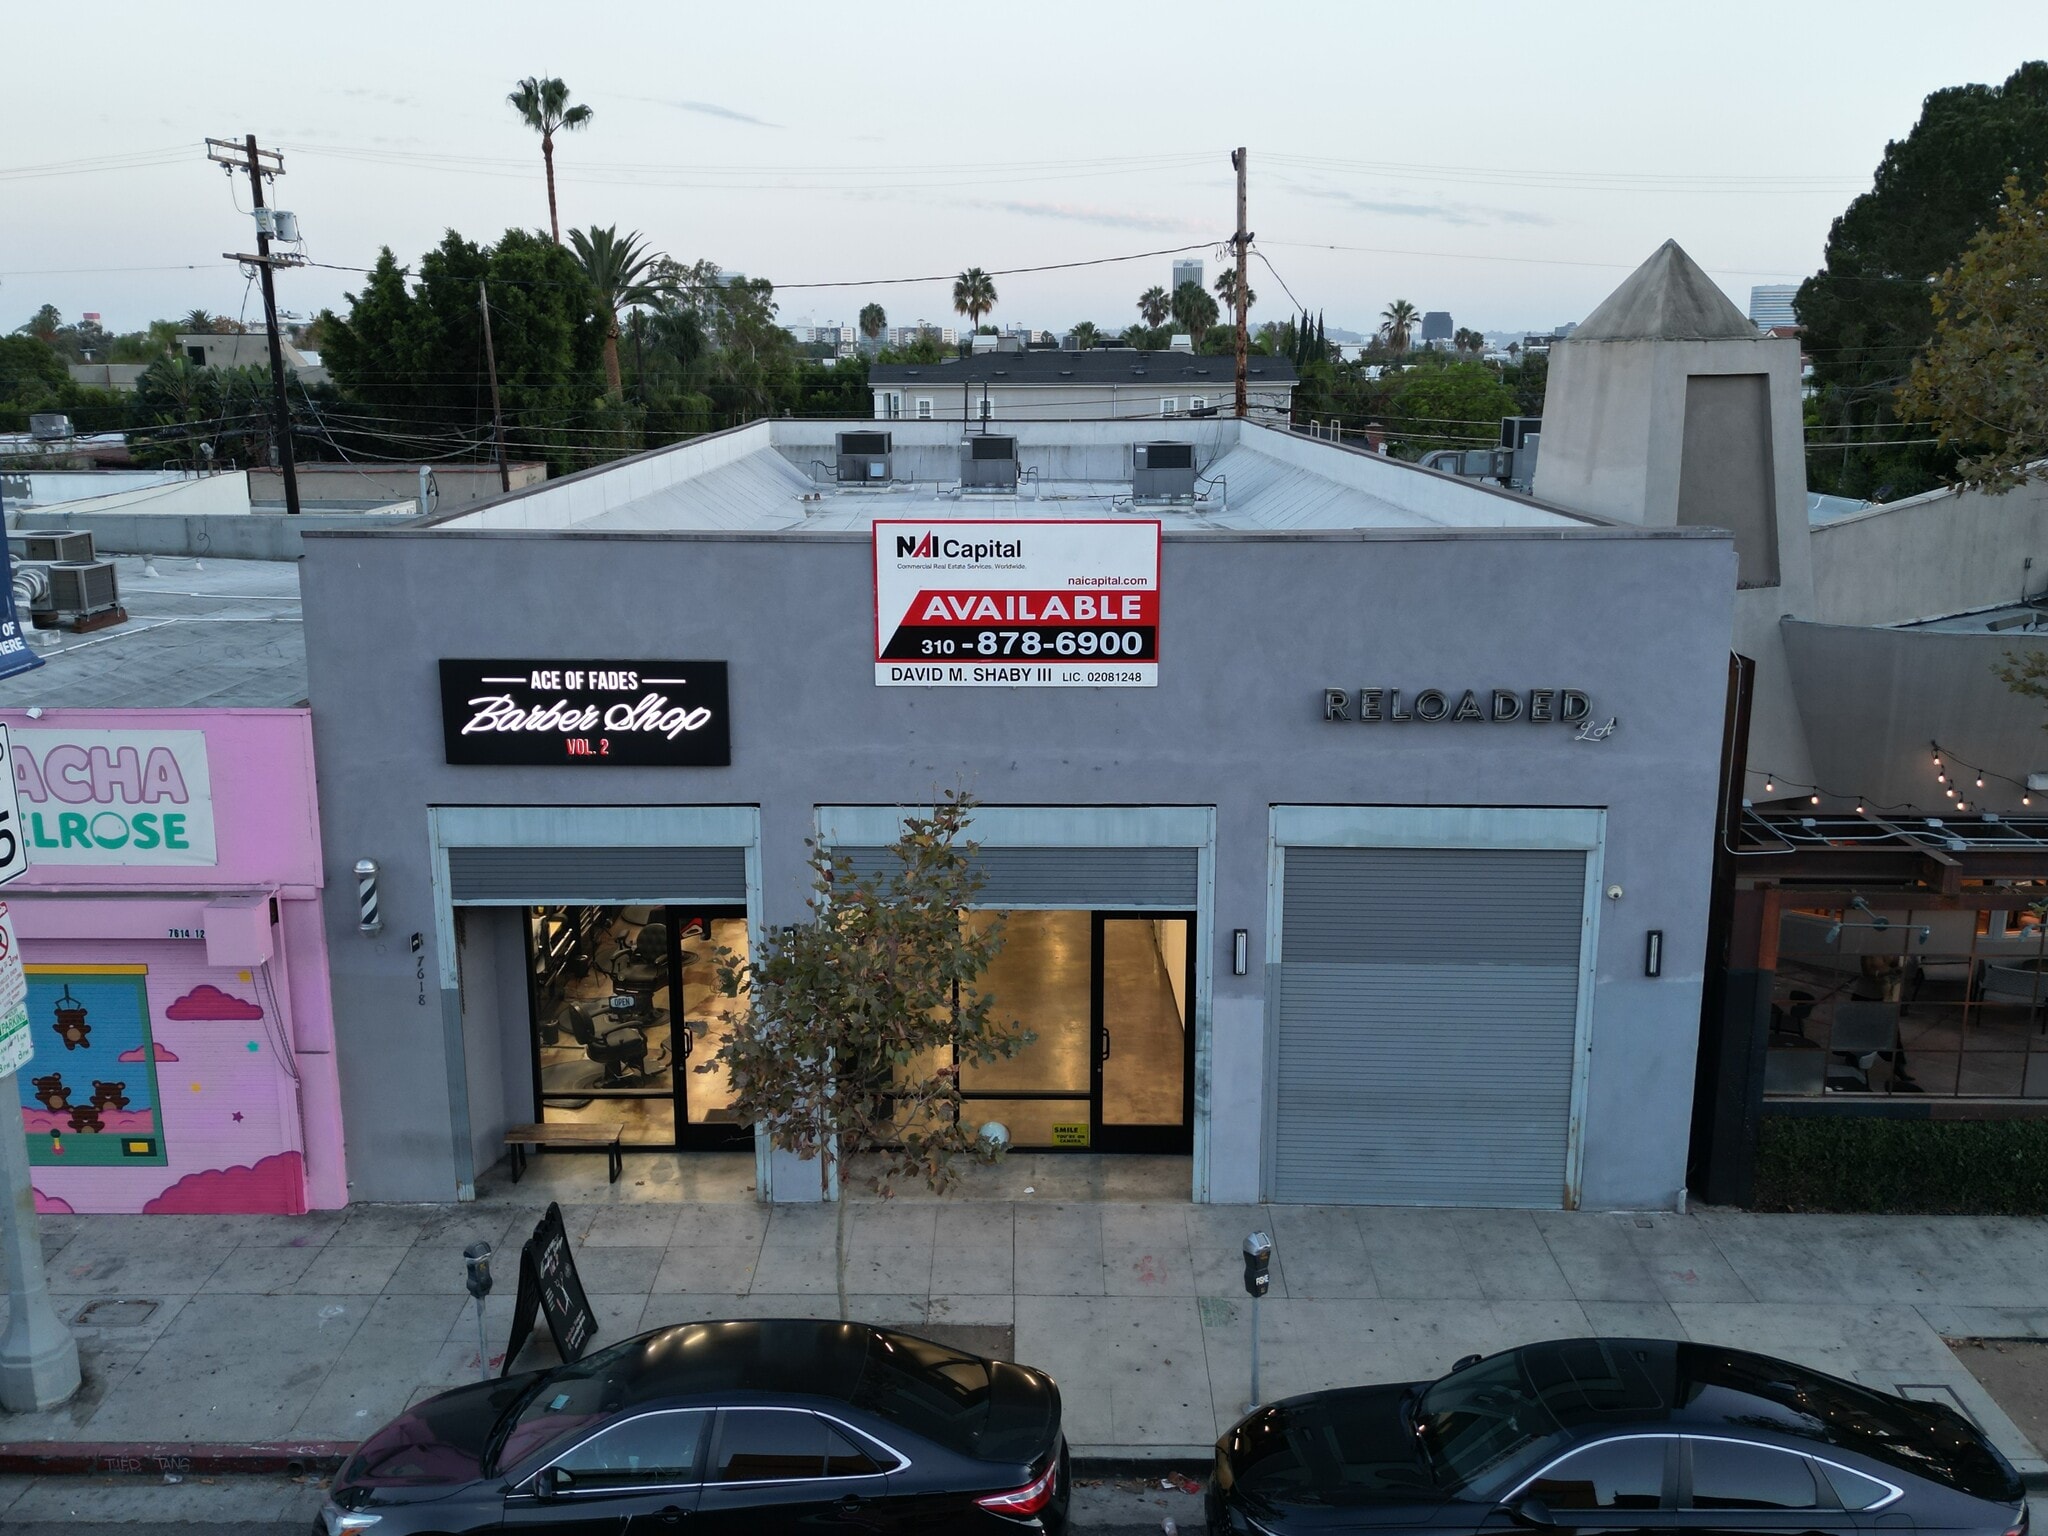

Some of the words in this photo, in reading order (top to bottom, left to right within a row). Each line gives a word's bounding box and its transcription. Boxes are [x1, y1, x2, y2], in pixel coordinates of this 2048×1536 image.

[897, 530, 939, 558] NAI
[943, 539, 1022, 563] Capital
[1068, 575, 1148, 588] naicapital.com
[921, 595, 1142, 621] AVAILABLE
[2, 621, 15, 637] OF
[531, 670, 561, 690] ACE
[564, 670, 585, 690] OF
[588, 671, 638, 691] FADES
[891, 667, 943, 682] DAVID
[949, 667, 968, 682] M.
[973, 667, 1032, 682] SHABY
[1037, 667, 1052, 682] III
[1062, 672, 1084, 682] LIC.
[1087, 672, 1142, 682] 02081248
[1323, 686, 1594, 724] RELOADED
[461, 693, 600, 736] Barber
[603, 692, 712, 740] Shop
[566, 738, 597, 755] VOL.
[600, 738, 609, 755] 2
[22, 811, 190, 850] LROSE
[168, 928, 190, 938] 7614
[416, 955, 426, 1006] 7618
[614, 998, 630, 1006] OPEN
